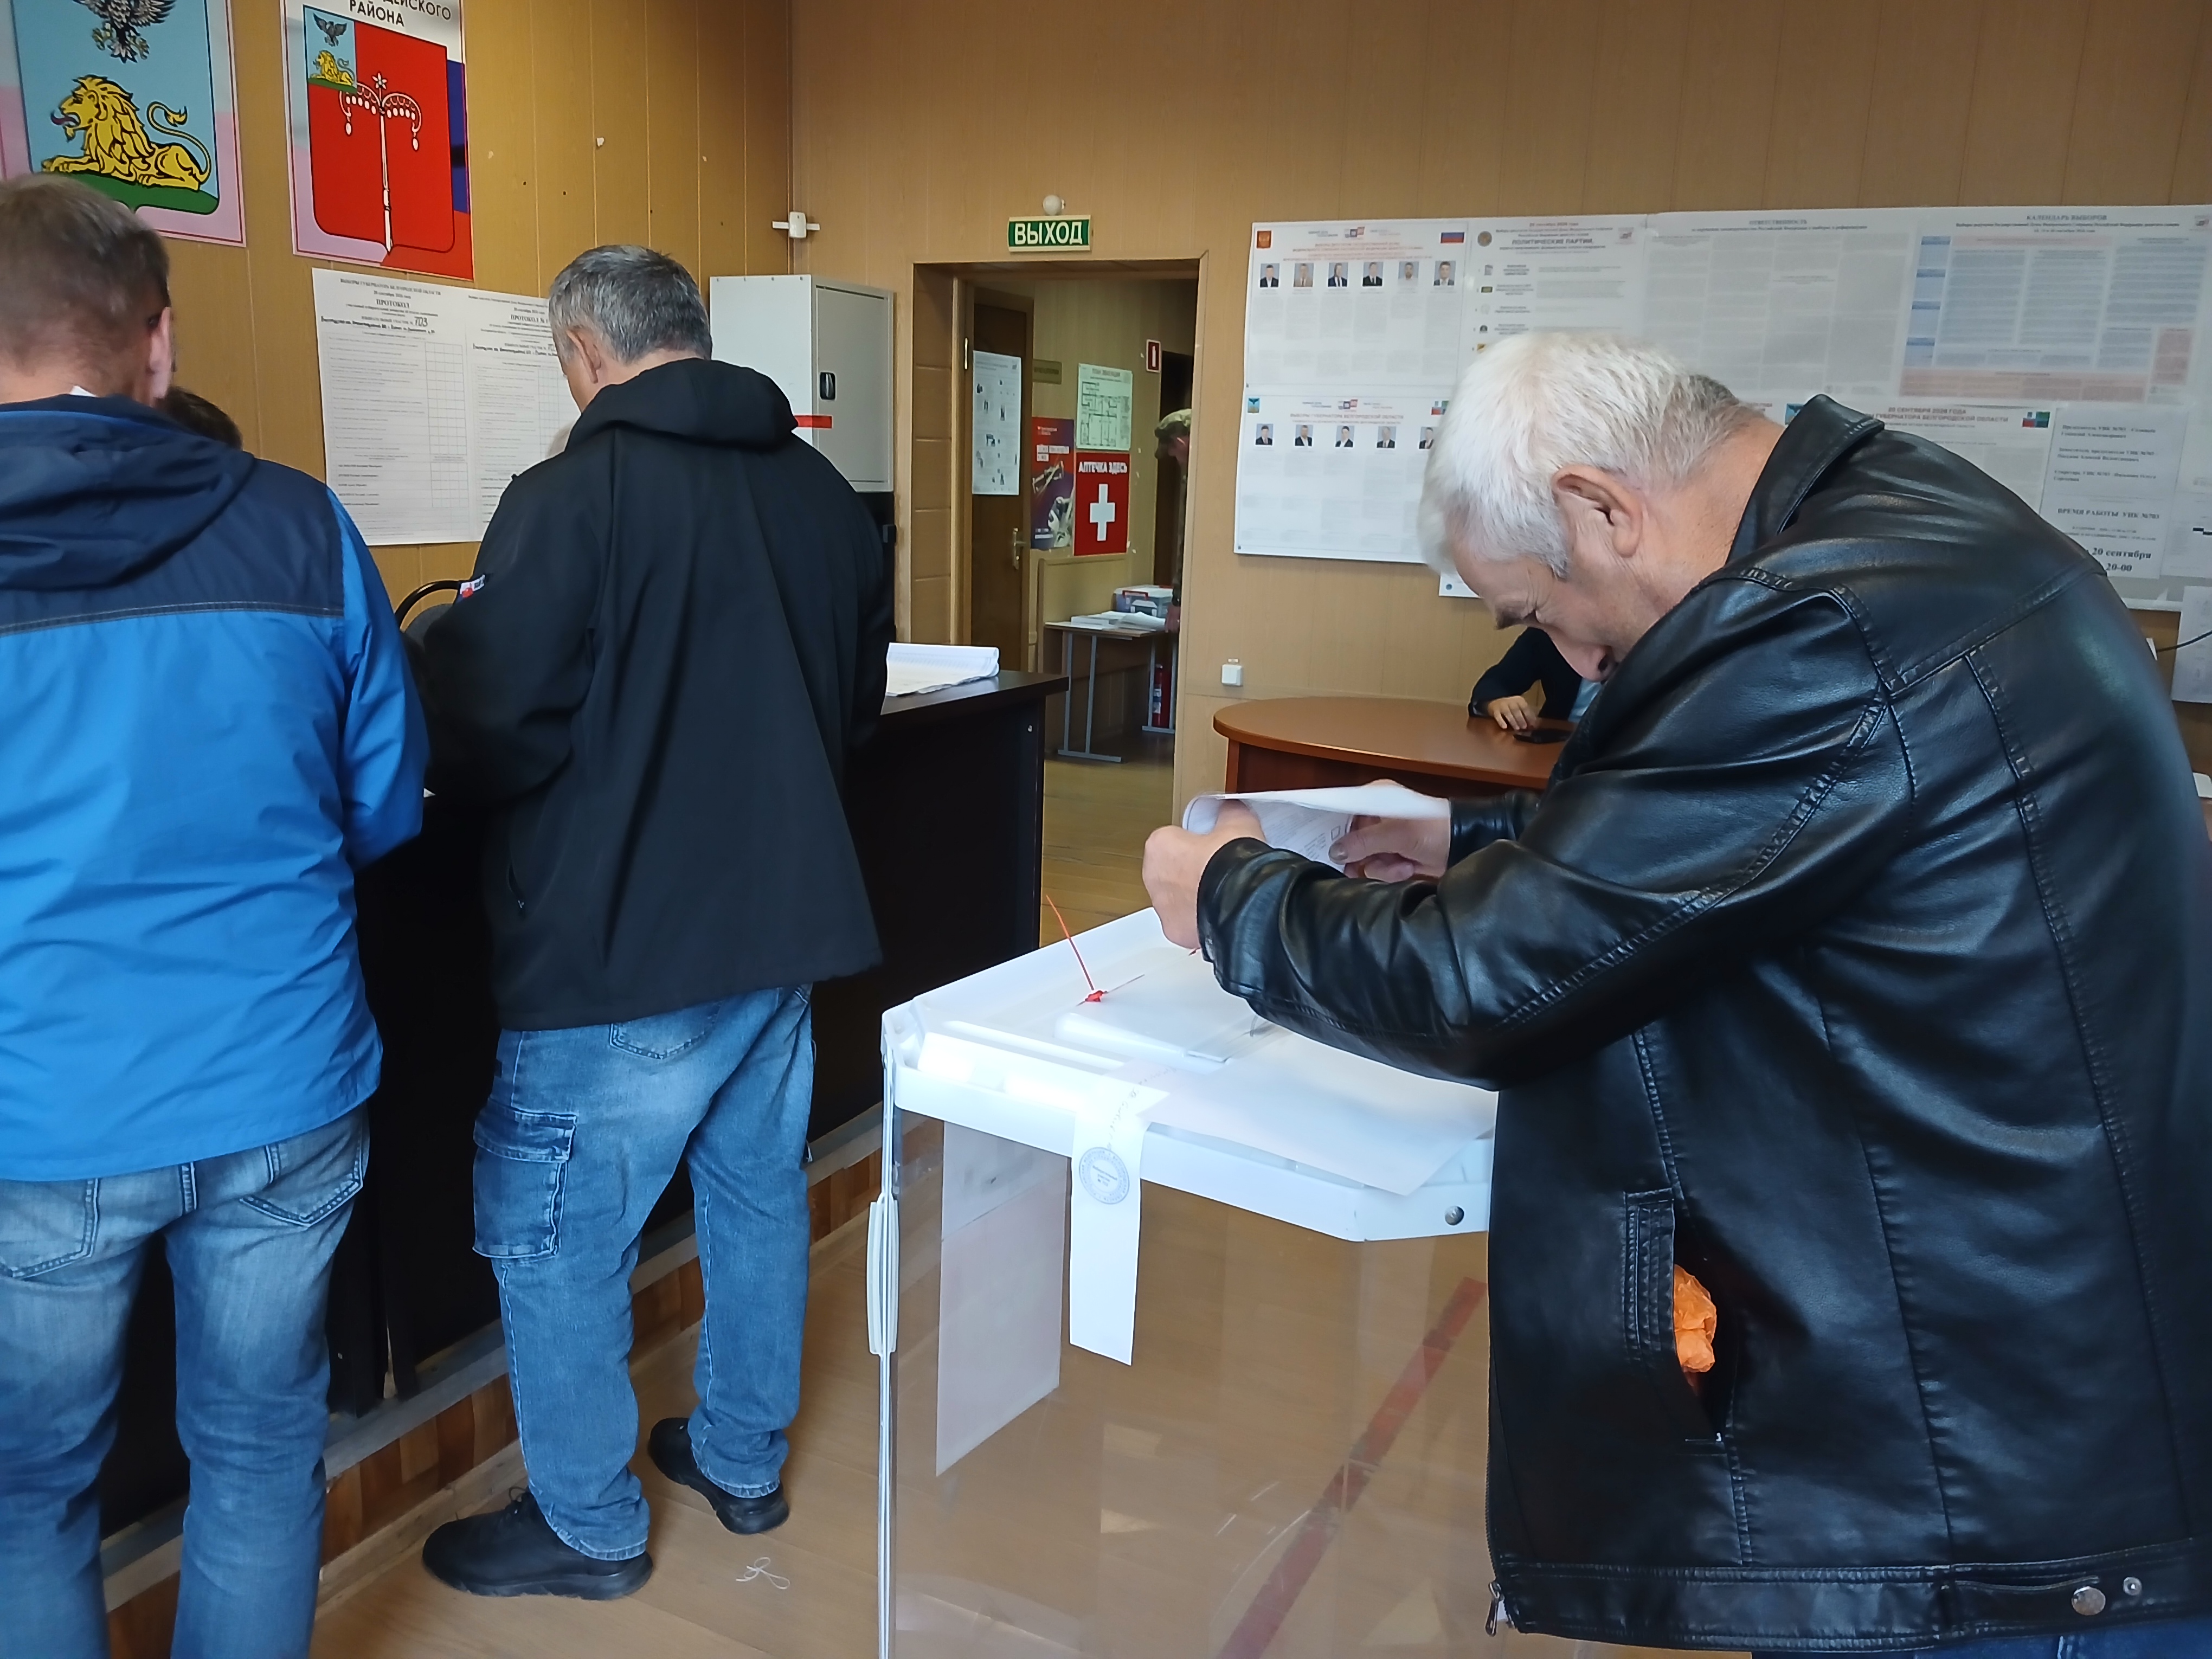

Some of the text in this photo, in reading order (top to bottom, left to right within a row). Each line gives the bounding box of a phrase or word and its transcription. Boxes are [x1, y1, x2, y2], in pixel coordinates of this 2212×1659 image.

[350, 0, 404, 27] РАЙОНА
[383, 0, 451, 20] СКОГО
[1014, 221, 1083, 246] ВЫХОД
[376, 299, 410, 308] ПРОТОКОЛ
[414, 316, 428, 327] 703
[510, 314, 539, 323] ПРОТОКОЛ
[1078, 461, 1128, 474] АПТЕЧКА ЗДЕСЬ
[2092, 547, 2151, 560] 20 сентября
[2106, 563, 2132, 571] 20-00
